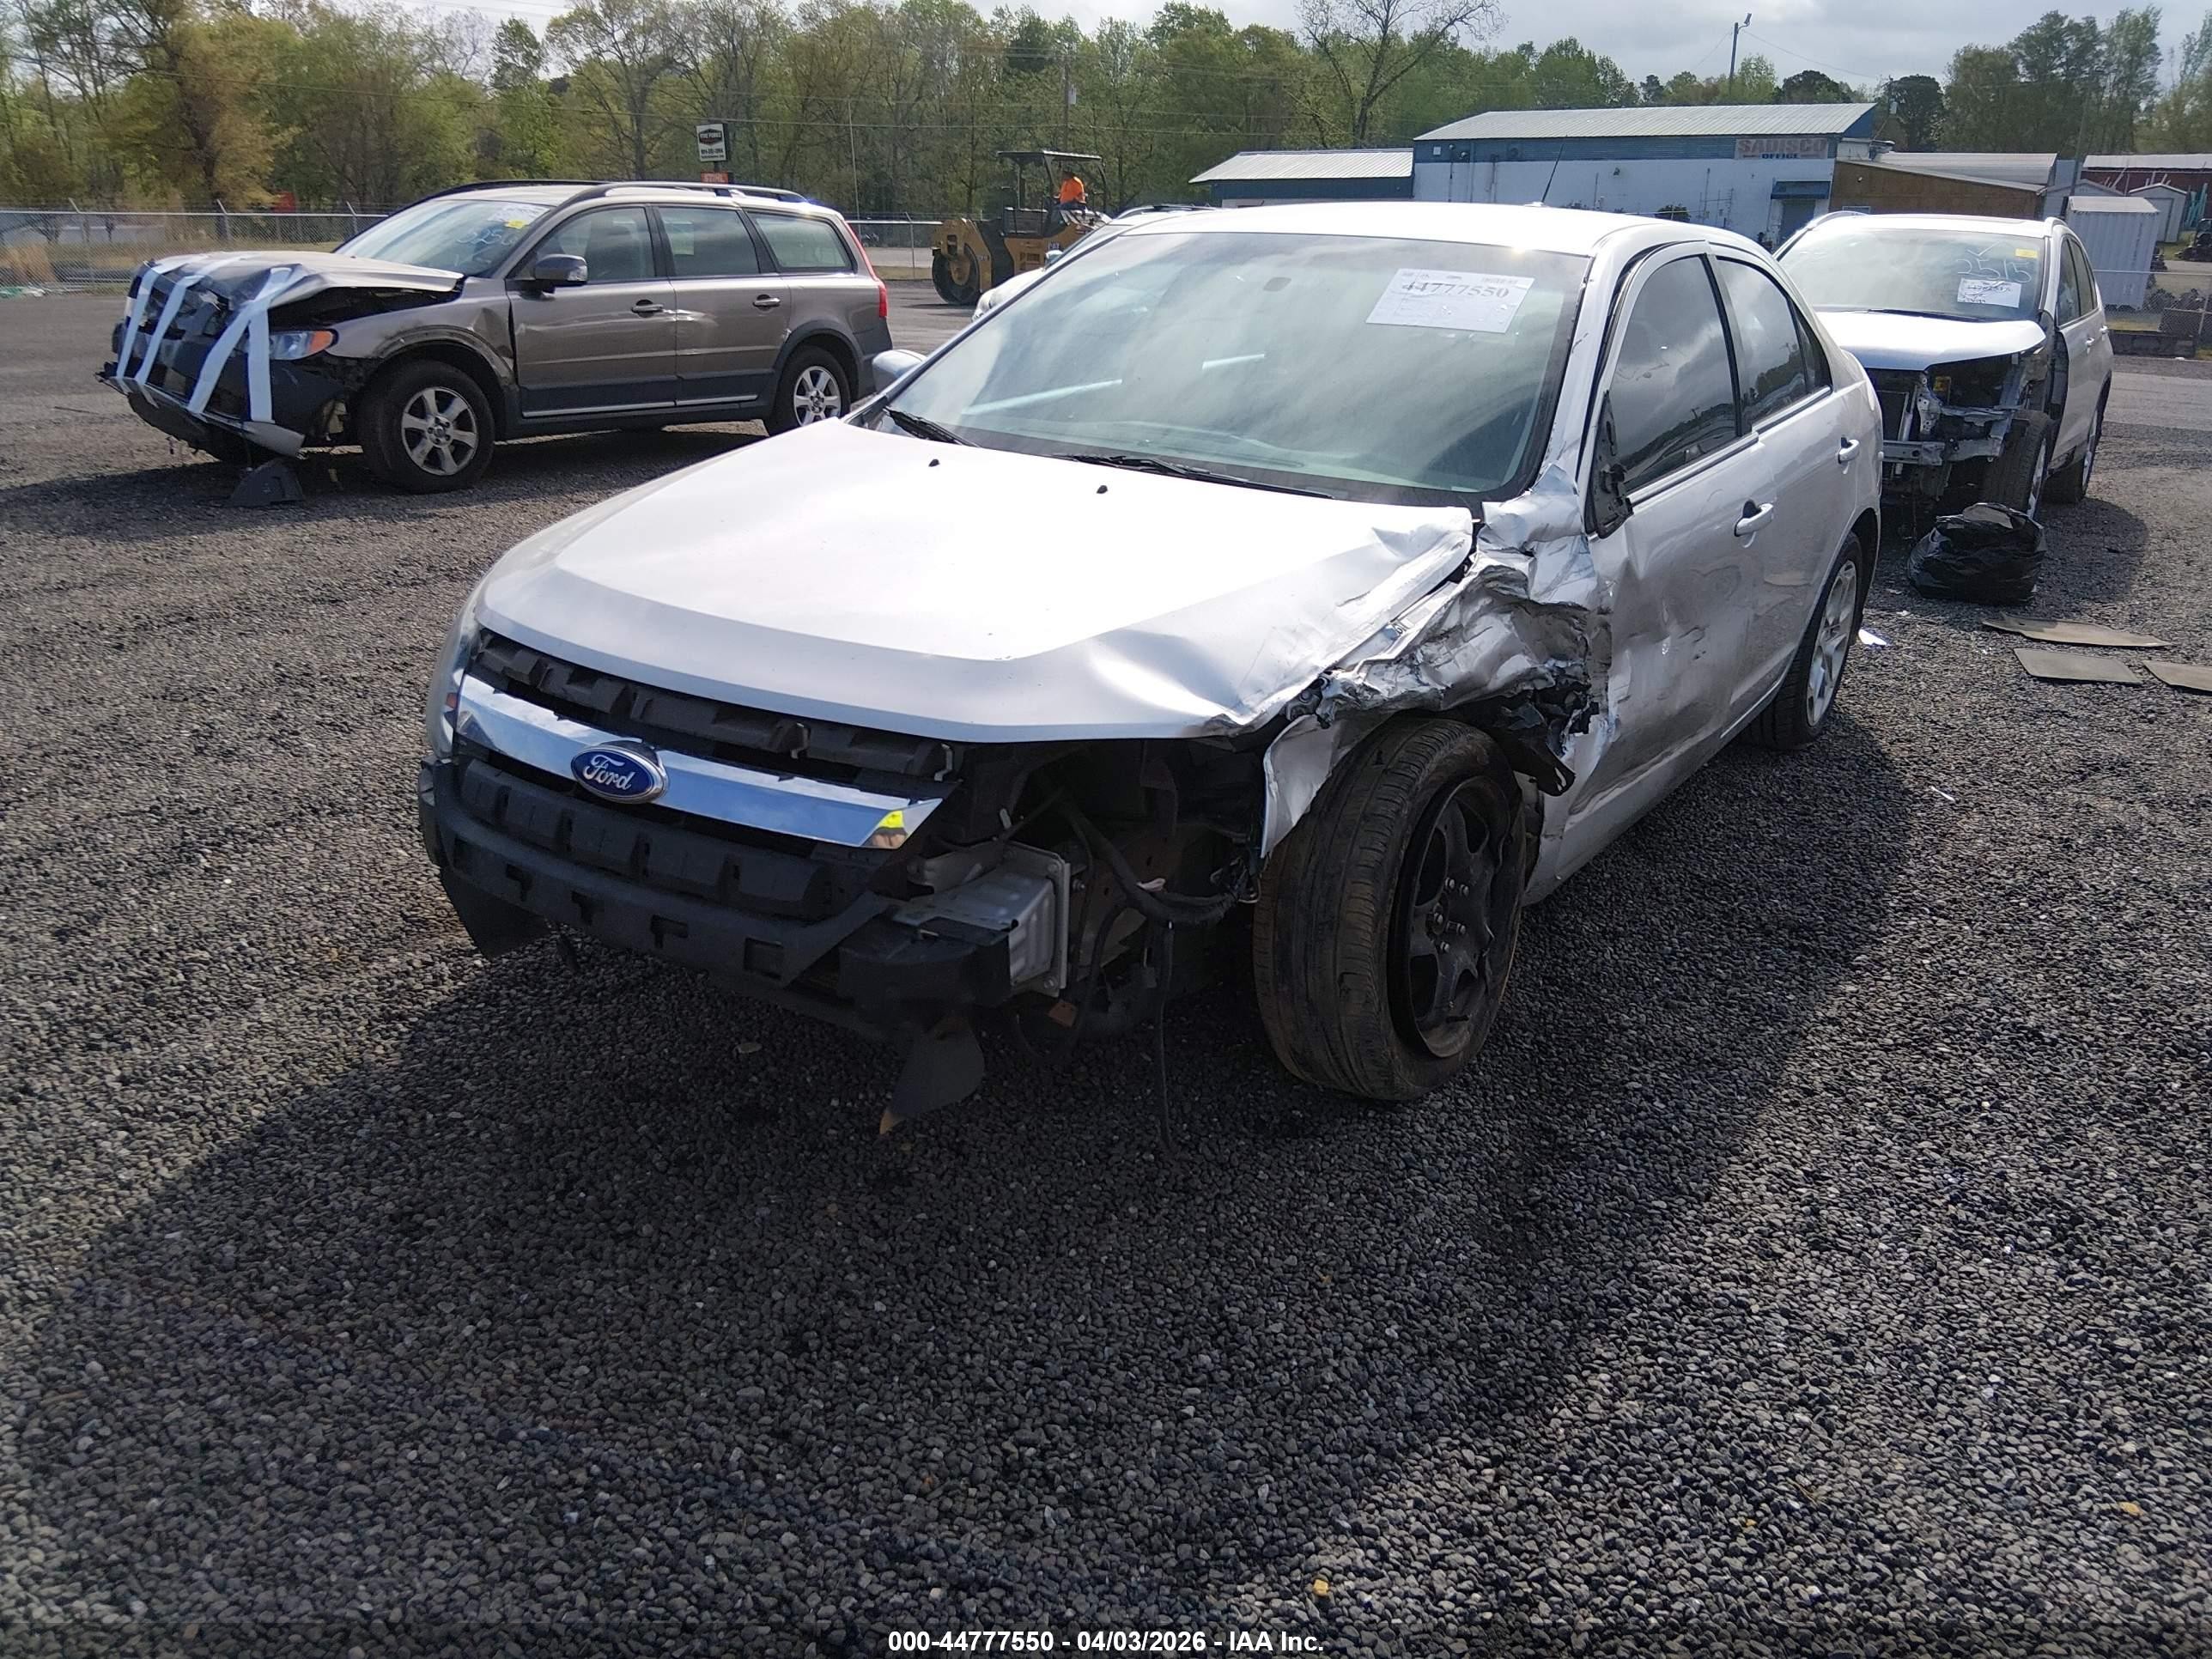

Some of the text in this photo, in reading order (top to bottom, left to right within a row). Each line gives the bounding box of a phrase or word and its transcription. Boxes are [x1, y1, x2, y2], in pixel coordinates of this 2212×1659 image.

[1738, 140, 1827, 152] SADISCO
[1957, 258, 2032, 283] 2515
[1401, 281, 1510, 299] 44777550
[582, 754, 635, 790] Ford
